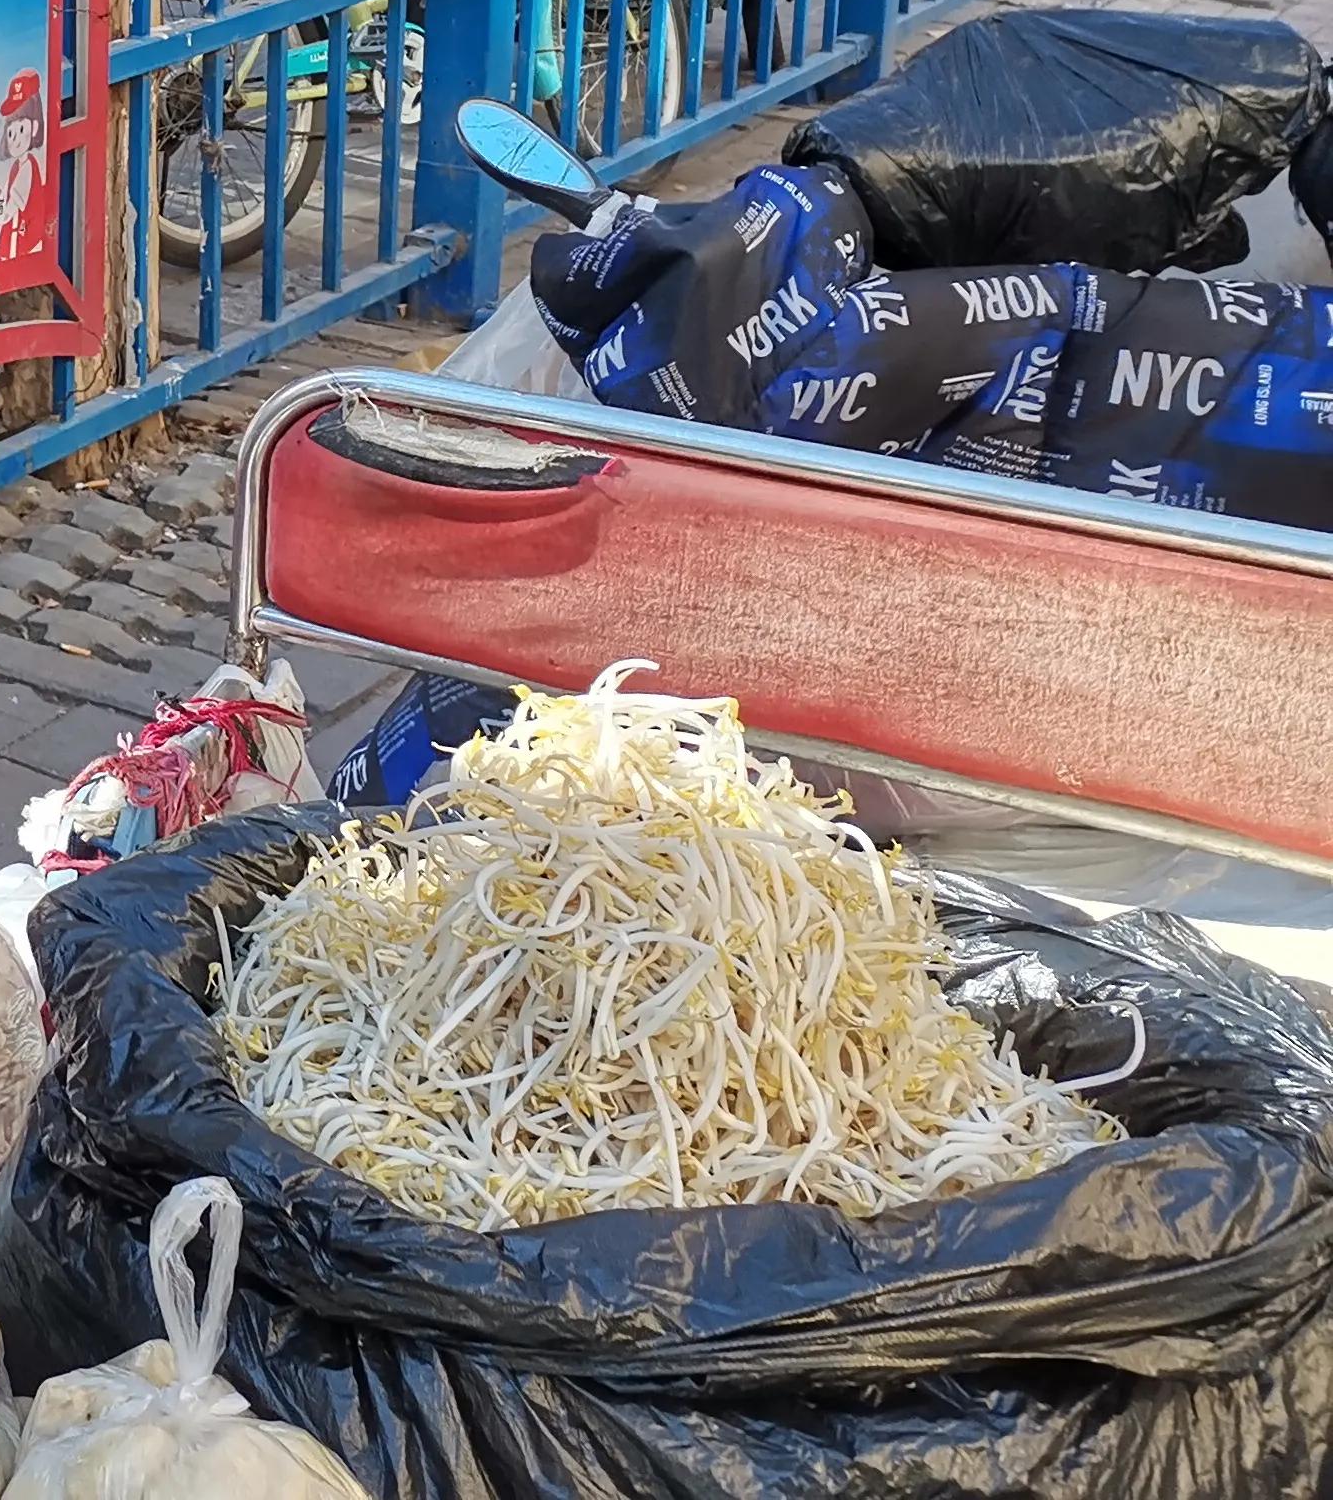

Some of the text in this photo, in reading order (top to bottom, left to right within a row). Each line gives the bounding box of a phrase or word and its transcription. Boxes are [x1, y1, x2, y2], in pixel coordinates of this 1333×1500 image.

[760, 168, 814, 213] LONG ISLAND
[726, 275, 818, 368] YORK
[951, 274, 1059, 325] YORK
[1109, 349, 1225, 417] NYC
[1254, 364, 1273, 426] LONG ISLAND
